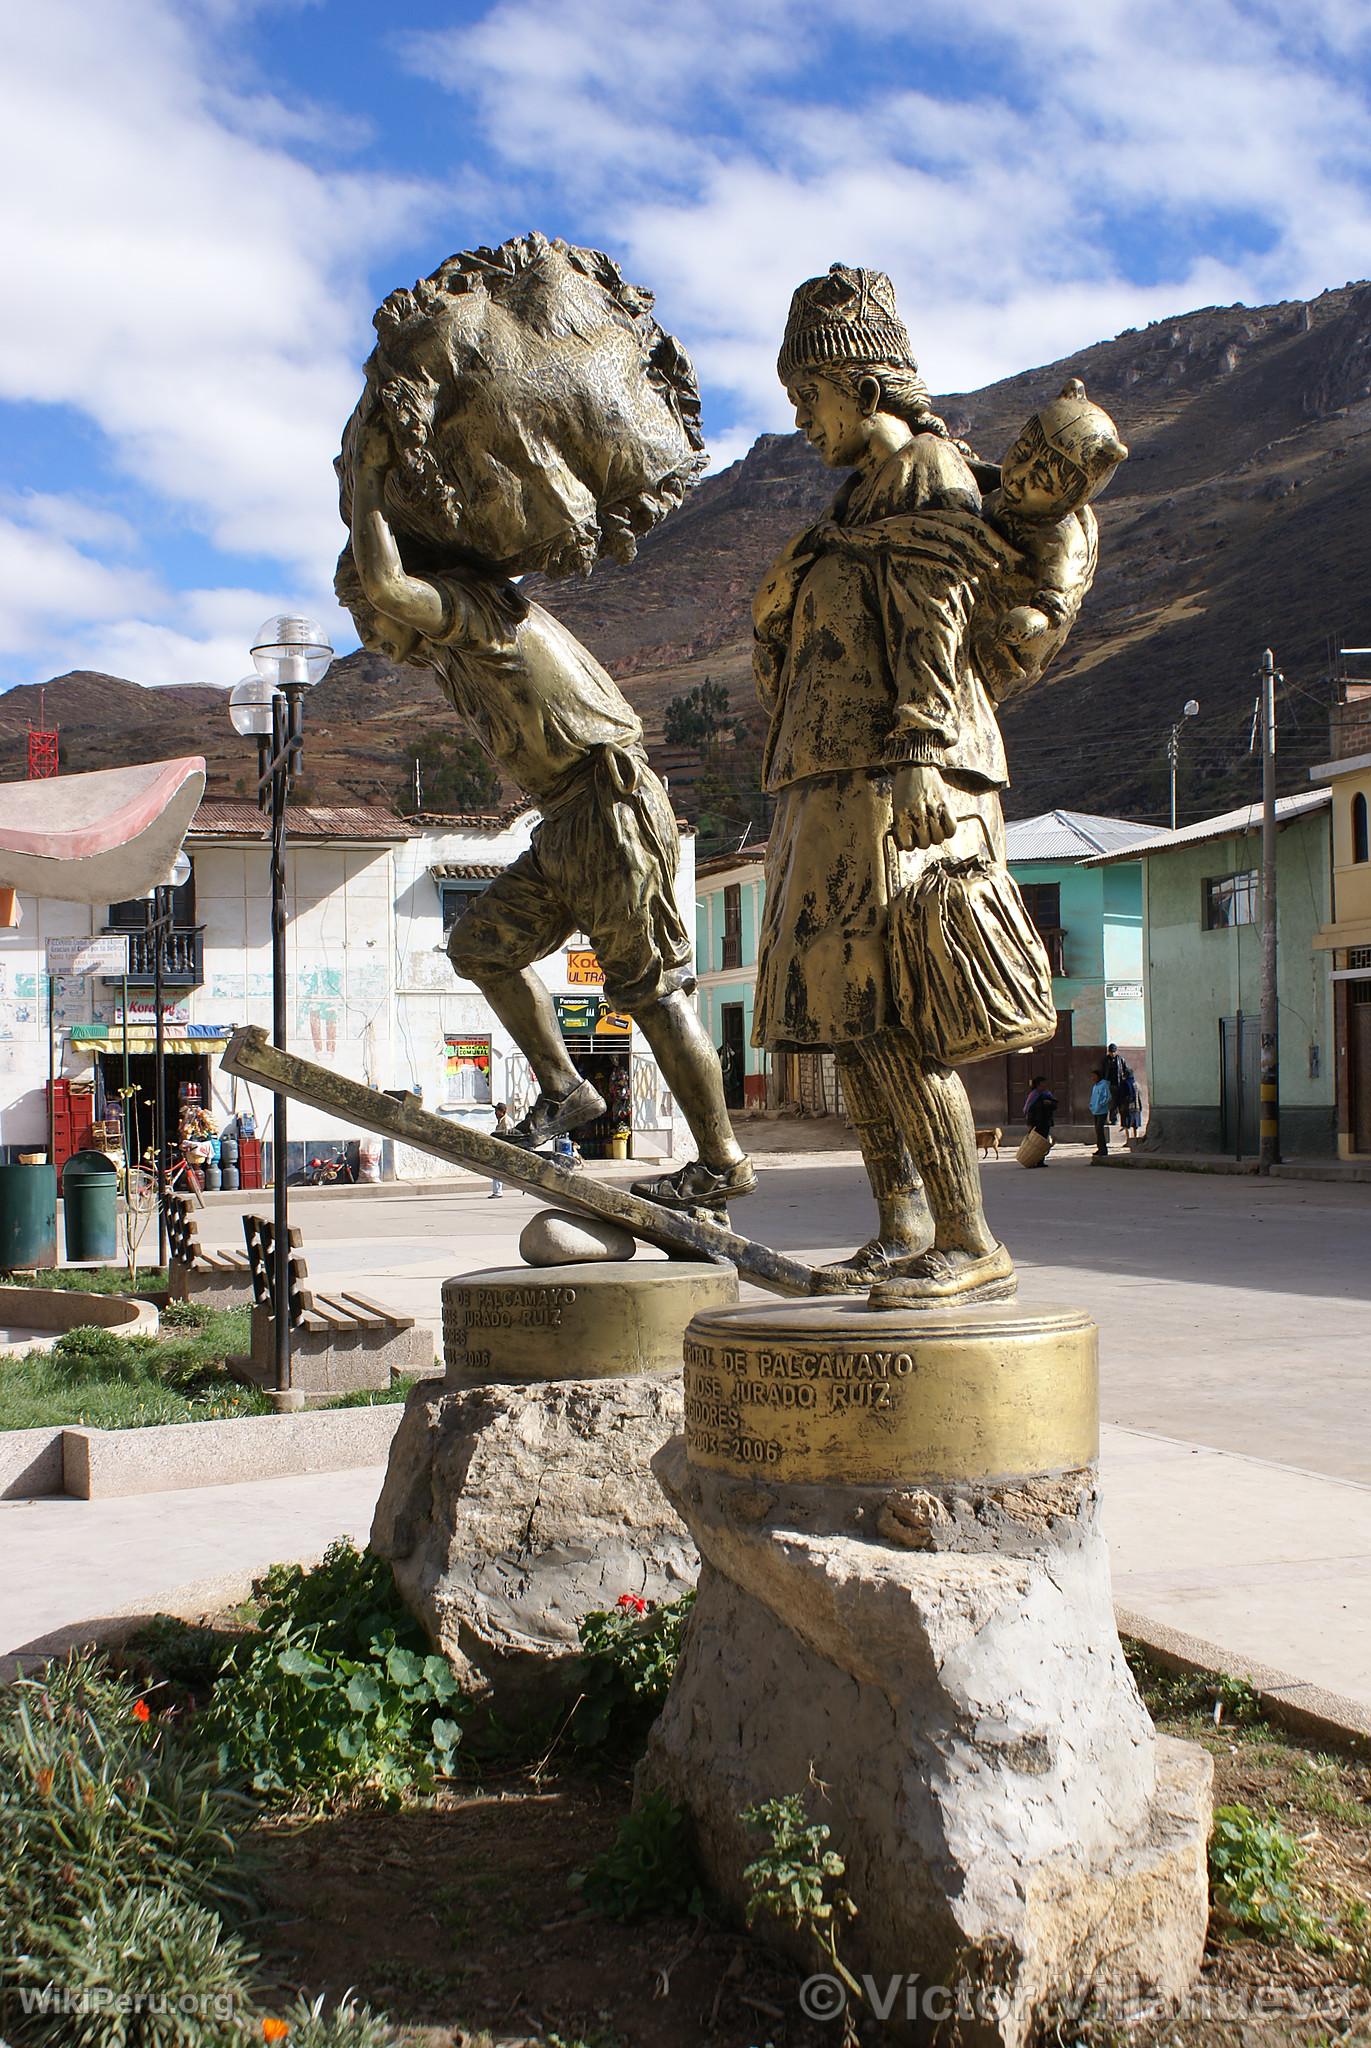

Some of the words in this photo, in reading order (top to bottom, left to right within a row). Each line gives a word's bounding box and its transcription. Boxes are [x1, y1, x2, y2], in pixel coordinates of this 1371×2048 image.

[478, 1288, 577, 1307] PALCAMAYO
[465, 1310, 511, 1328] JURADO
[522, 1308, 562, 1326] RUIZ
[723, 1351, 747, 1374] DE
[760, 1353, 913, 1378] PALCAMAYO
[732, 1382, 816, 1406] JURADO
[832, 1382, 890, 1407] RUIZ
